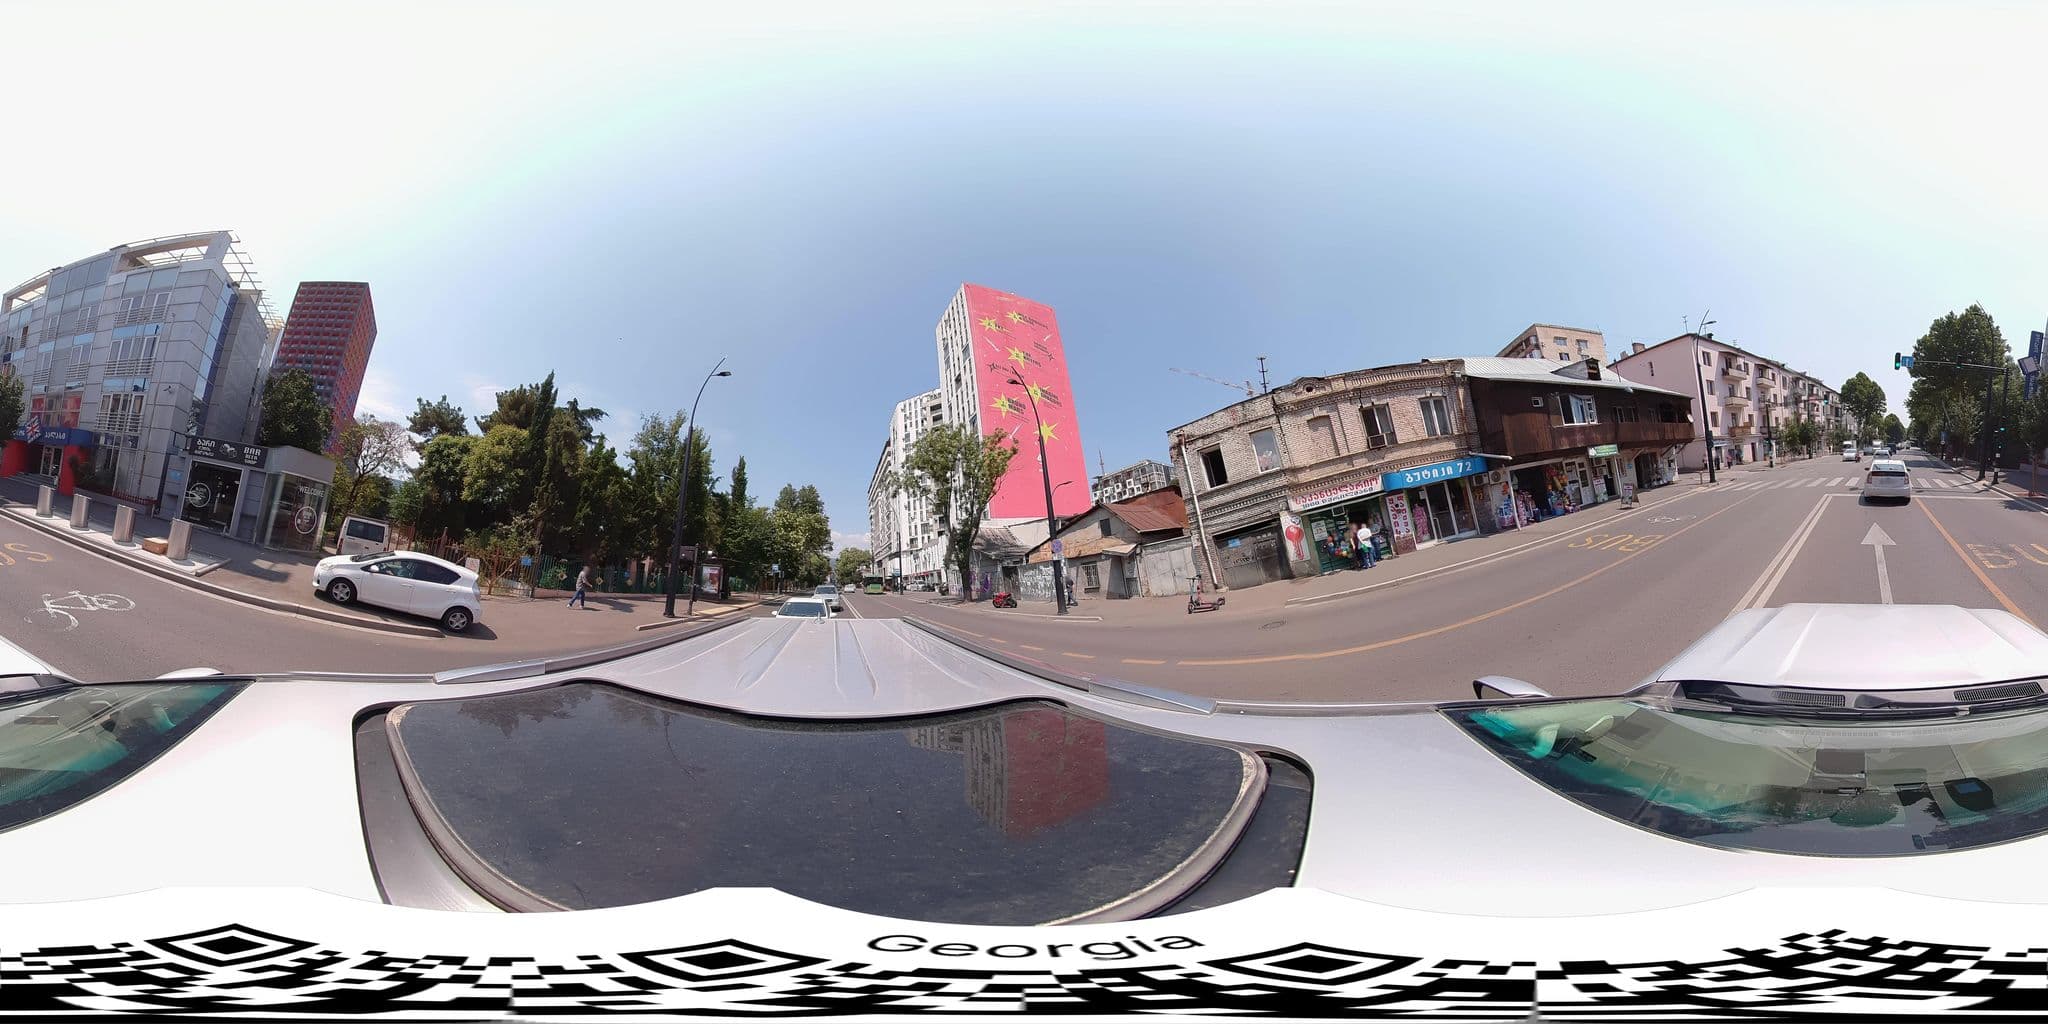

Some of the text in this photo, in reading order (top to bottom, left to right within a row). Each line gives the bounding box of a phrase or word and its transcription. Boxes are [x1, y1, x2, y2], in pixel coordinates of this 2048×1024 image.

[243, 446, 262, 456] BAR
[1405, 461, 1472, 483] ბუტიკი 72
[298, 485, 325, 498] WELCOME
